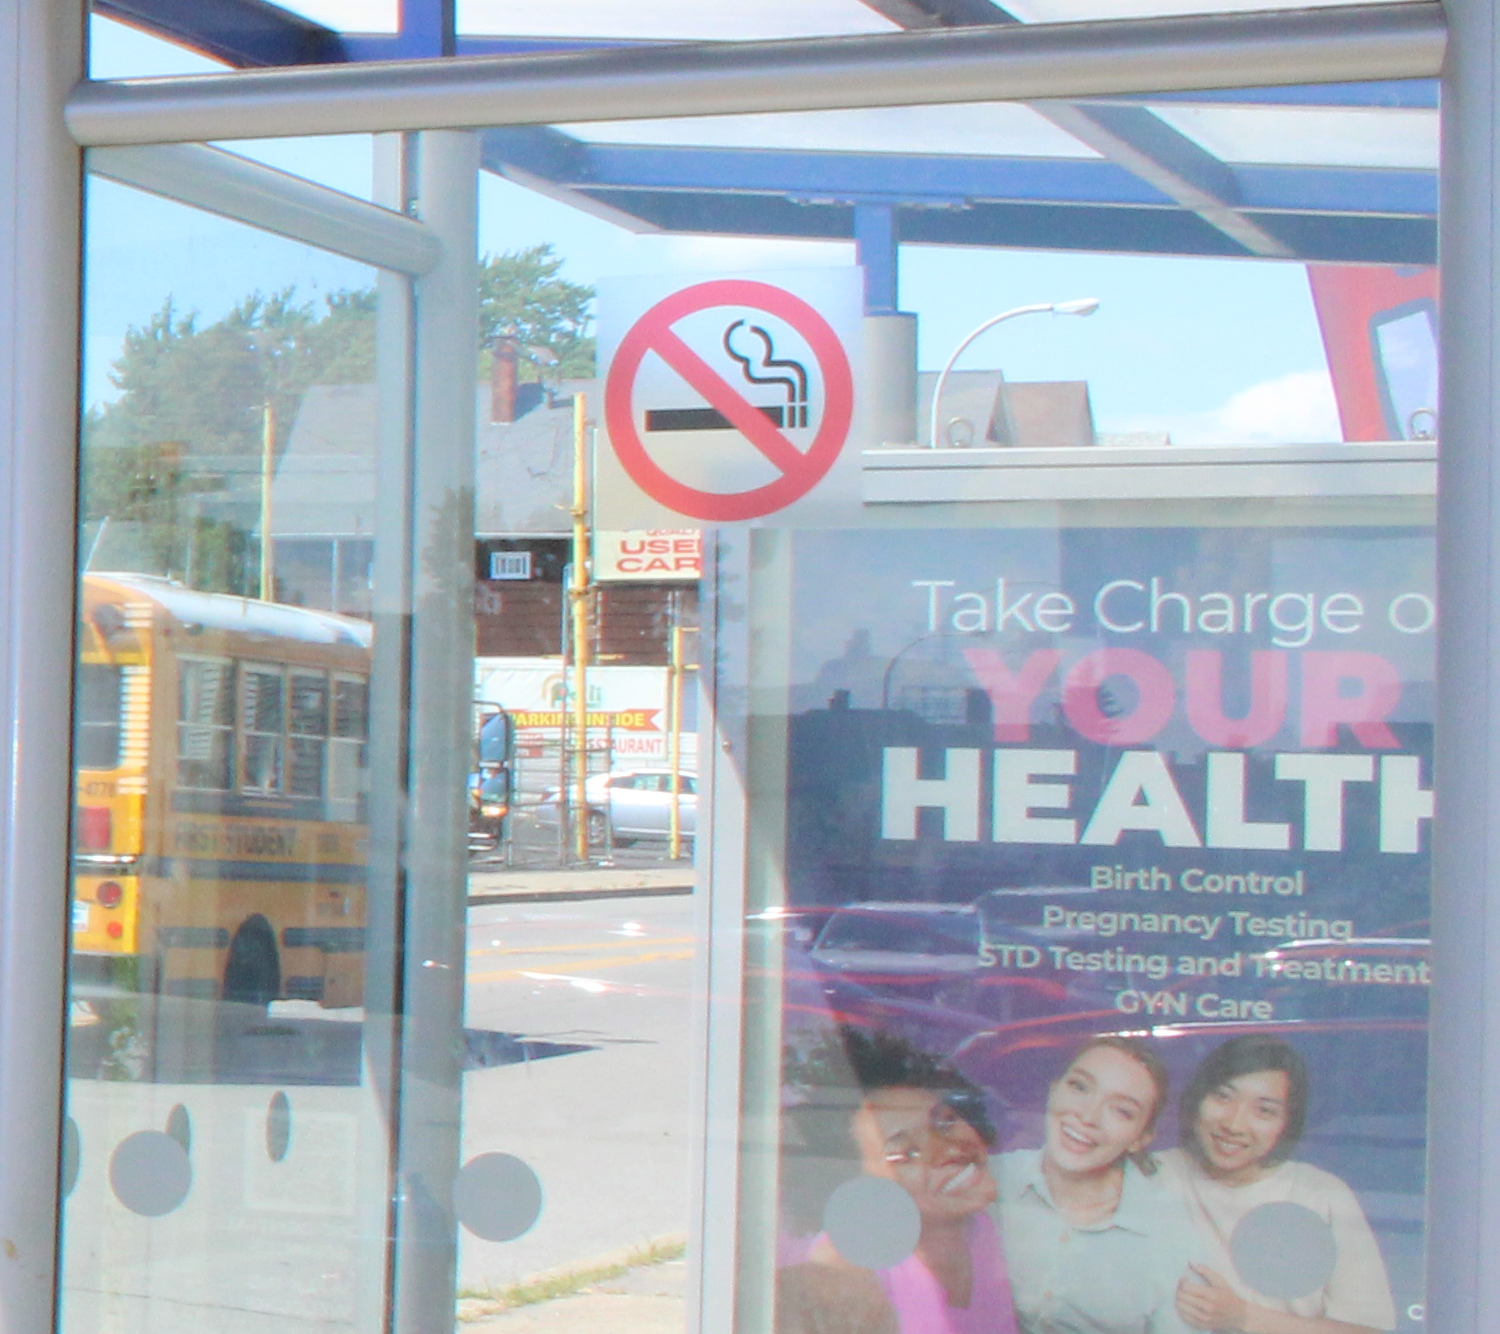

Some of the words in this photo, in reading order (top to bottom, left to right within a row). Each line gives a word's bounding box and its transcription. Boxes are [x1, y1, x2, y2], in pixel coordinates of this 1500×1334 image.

[620, 539, 702, 555] USE
[912, 577, 1075, 633] Take
[1093, 577, 1364, 648] Charge
[963, 646, 1403, 748] YOUR
[1090, 865, 1172, 893] Birth
[1180, 868, 1304, 896] Control
[1043, 906, 1220, 940] Pregnancy
[1228, 911, 1352, 941] Testing
[977, 942, 1041, 969] STD
[1049, 944, 1166, 979] Testing
[1177, 951, 1241, 977] and
[1255, 953, 1431, 985] Treatment
[1114, 990, 1187, 1017] GYN
[1197, 993, 1273, 1020] Care
